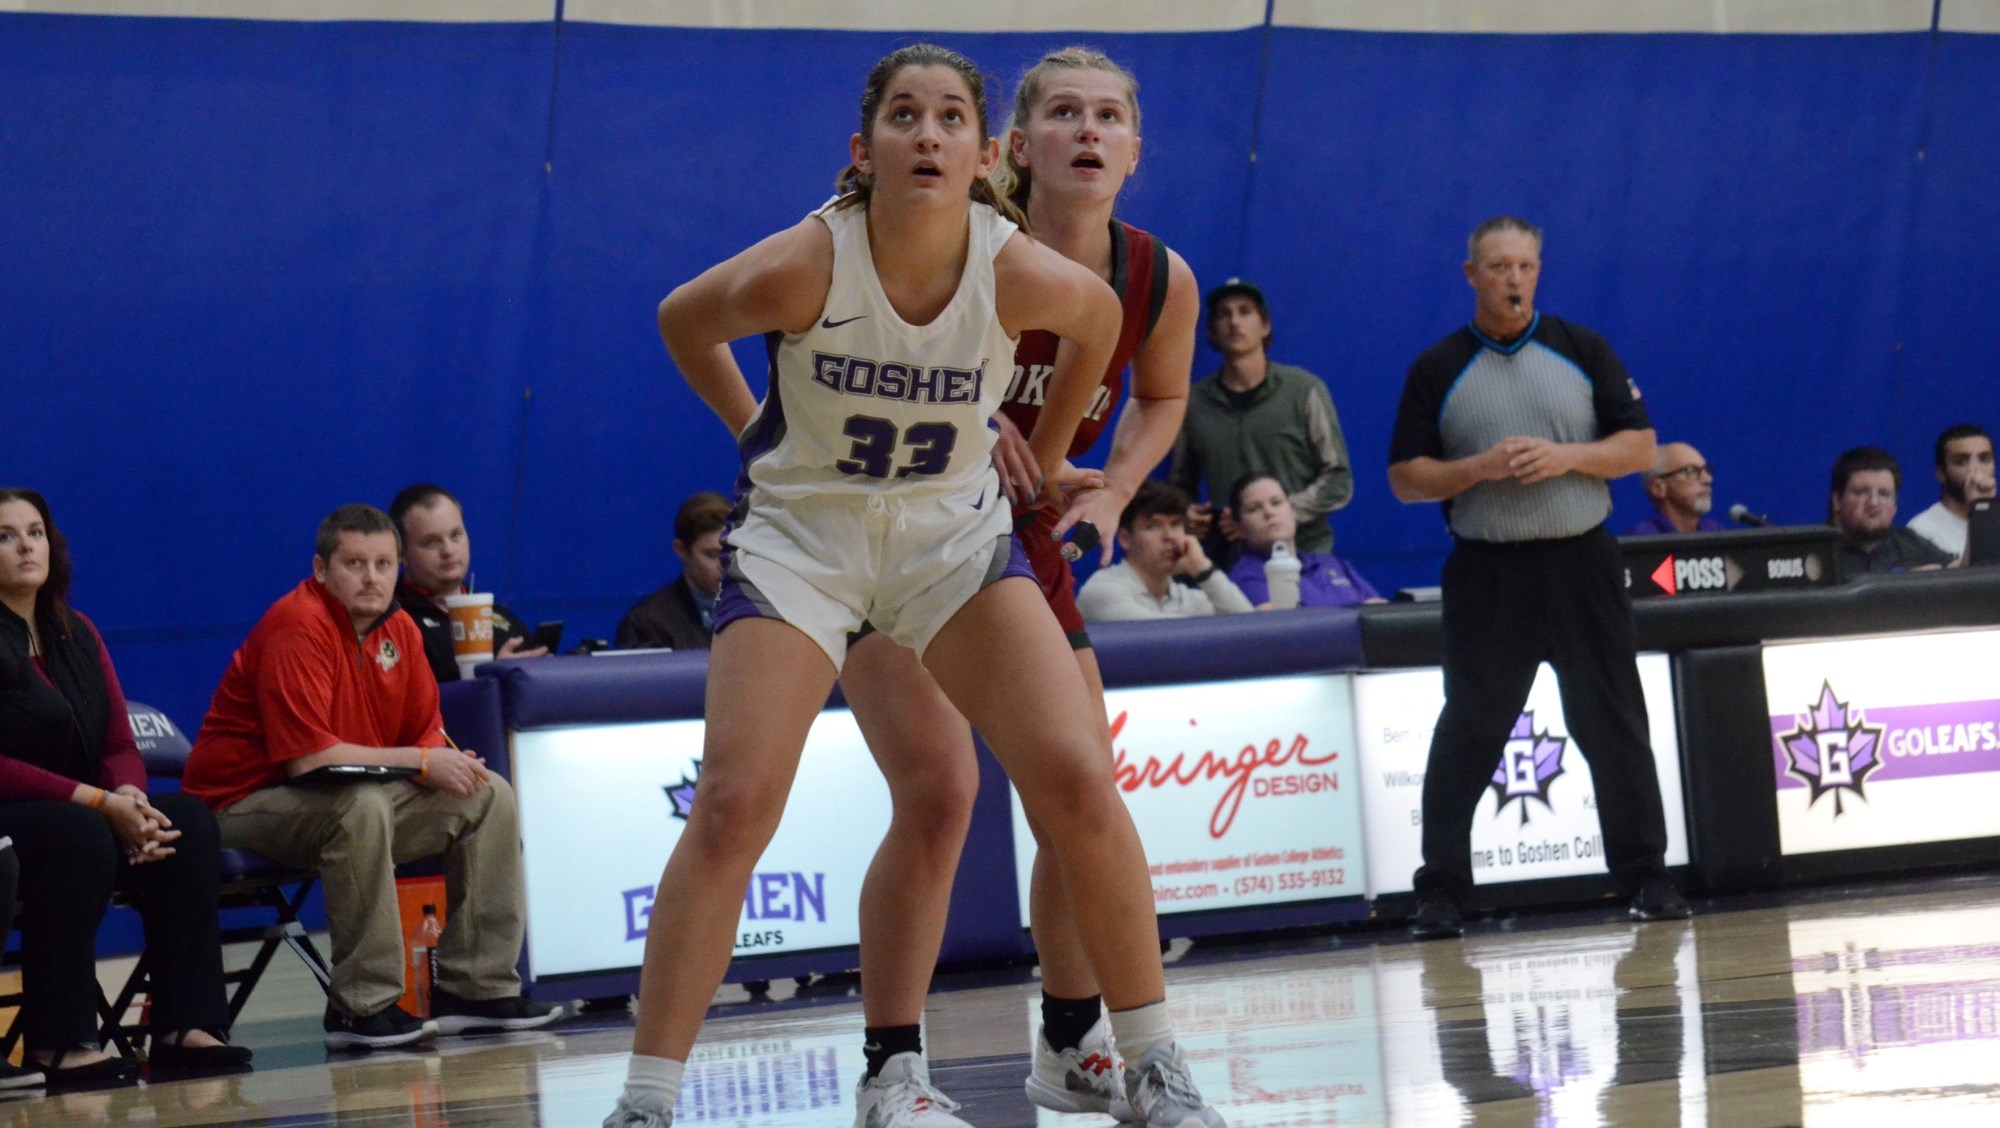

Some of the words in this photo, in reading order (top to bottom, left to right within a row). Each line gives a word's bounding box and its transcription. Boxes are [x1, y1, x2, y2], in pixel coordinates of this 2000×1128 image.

[836, 414, 958, 478] 33
[1675, 556, 1726, 590] POSS
[1767, 557, 1804, 580] BONUS
[1253, 772, 1339, 798] DESIGN
[1254, 852, 1281, 866] Goshen
[1282, 849, 1309, 865] College
[1311, 845, 1343, 861] Athletics
[1499, 845, 1513, 866] to
[1517, 840, 1569, 864] Goshen
[1234, 874, 1273, 896] (574)
[1278, 868, 1344, 891] 535-9132
